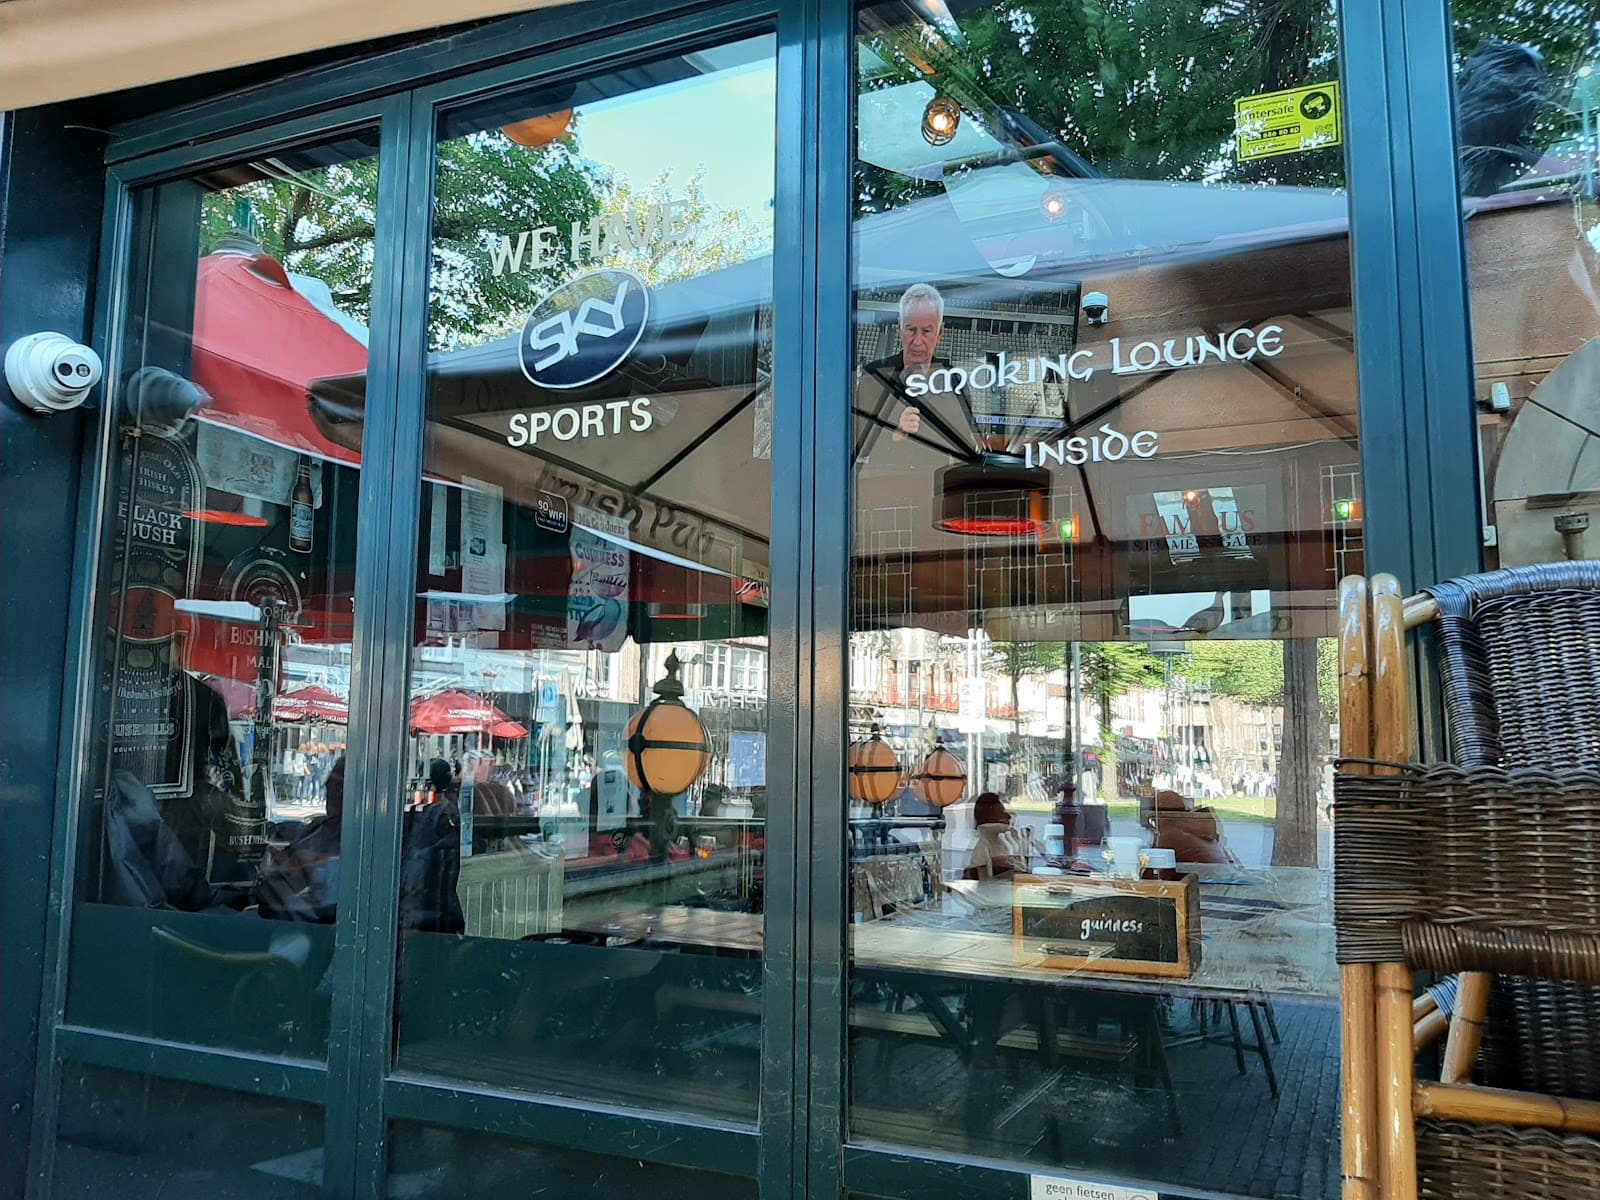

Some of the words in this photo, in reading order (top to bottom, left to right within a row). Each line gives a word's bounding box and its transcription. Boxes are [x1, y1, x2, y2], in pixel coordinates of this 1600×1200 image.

[487, 225, 558, 277] WE
[571, 199, 690, 261] HAVE
[529, 280, 629, 373] SKY
[904, 350, 1094, 398] SMOKING
[1109, 325, 1285, 376] LOUNGE
[506, 397, 654, 448] SPORTS
[1023, 423, 1160, 470] INSIDE
[138, 477, 176, 495] HISKEY
[548, 509, 566, 522] WIFI
[246, 655, 276, 669] MAL
[1080, 912, 1143, 940] guinness
[1046, 1184, 1073, 1196] geen
[1076, 1185, 1115, 1200] fietsen
